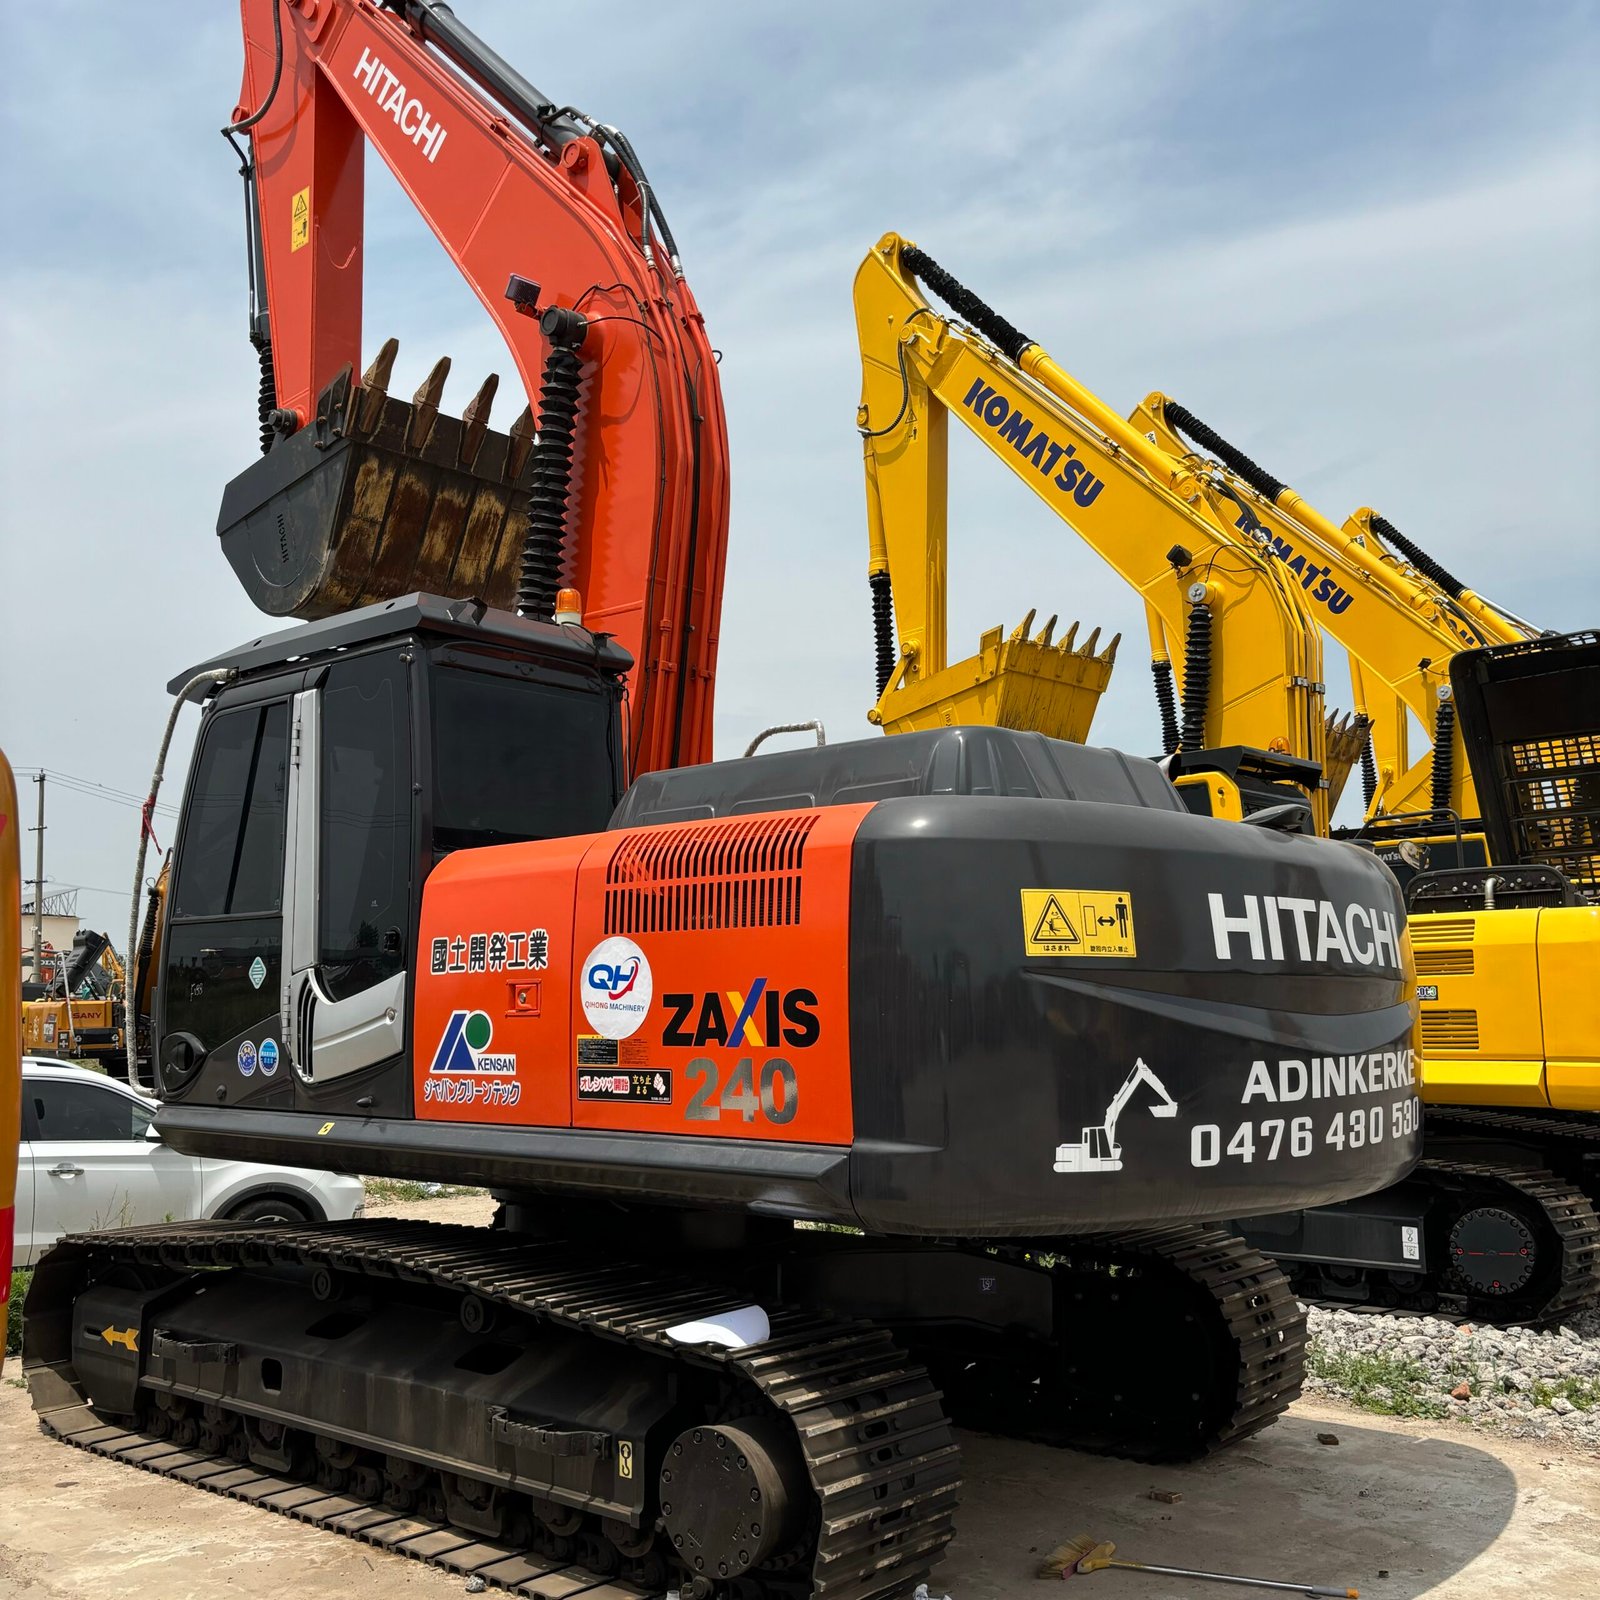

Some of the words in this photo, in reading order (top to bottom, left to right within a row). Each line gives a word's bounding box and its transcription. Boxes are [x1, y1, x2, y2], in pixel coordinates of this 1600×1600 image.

[353, 46, 447, 163] HITACHI
[962, 377, 1105, 508] KOMATSU
[277, 513, 289, 563] HITACHI
[1379, 851, 1402, 861] ATSU
[431, 928, 548, 975] 國土開発工業
[1207, 892, 1403, 970] HITACHI
[588, 963, 636, 991] QH
[585, 1001, 609, 1010] QIHONG
[609, 1003, 645, 1012] MACHINERY
[662, 977, 820, 1048] ZAXIS
[477, 1058, 515, 1071] KENSAN
[684, 1057, 799, 1124] 240
[1241, 1049, 1416, 1104] ADINKERKE
[1190, 1115, 1313, 1168] 0476
[1325, 1105, 1384, 1151] 430
[1391, 1096, 1420, 1139] 530
